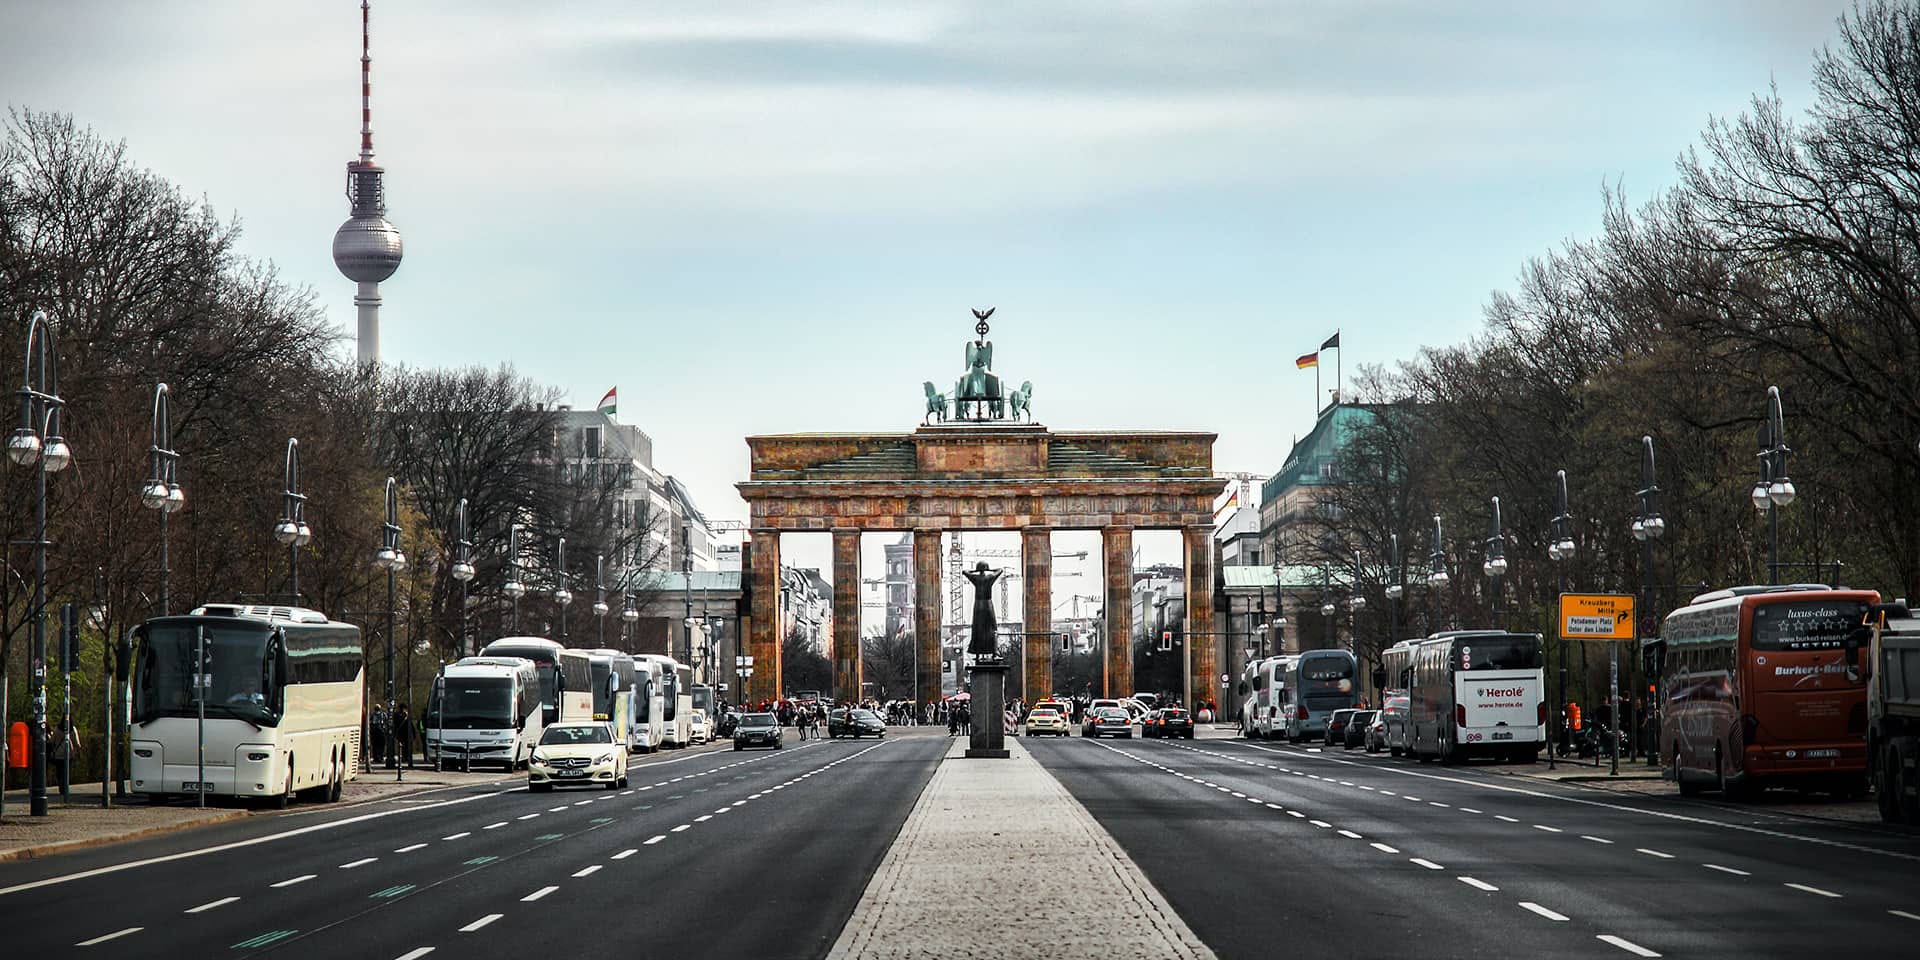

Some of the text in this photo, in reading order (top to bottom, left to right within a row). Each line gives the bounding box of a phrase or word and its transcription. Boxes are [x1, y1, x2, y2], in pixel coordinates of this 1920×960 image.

[1579, 599, 1615, 607] Kreuzberg
[1787, 608, 1839, 618] luxus-class
[1486, 686, 1523, 697] Herolé
